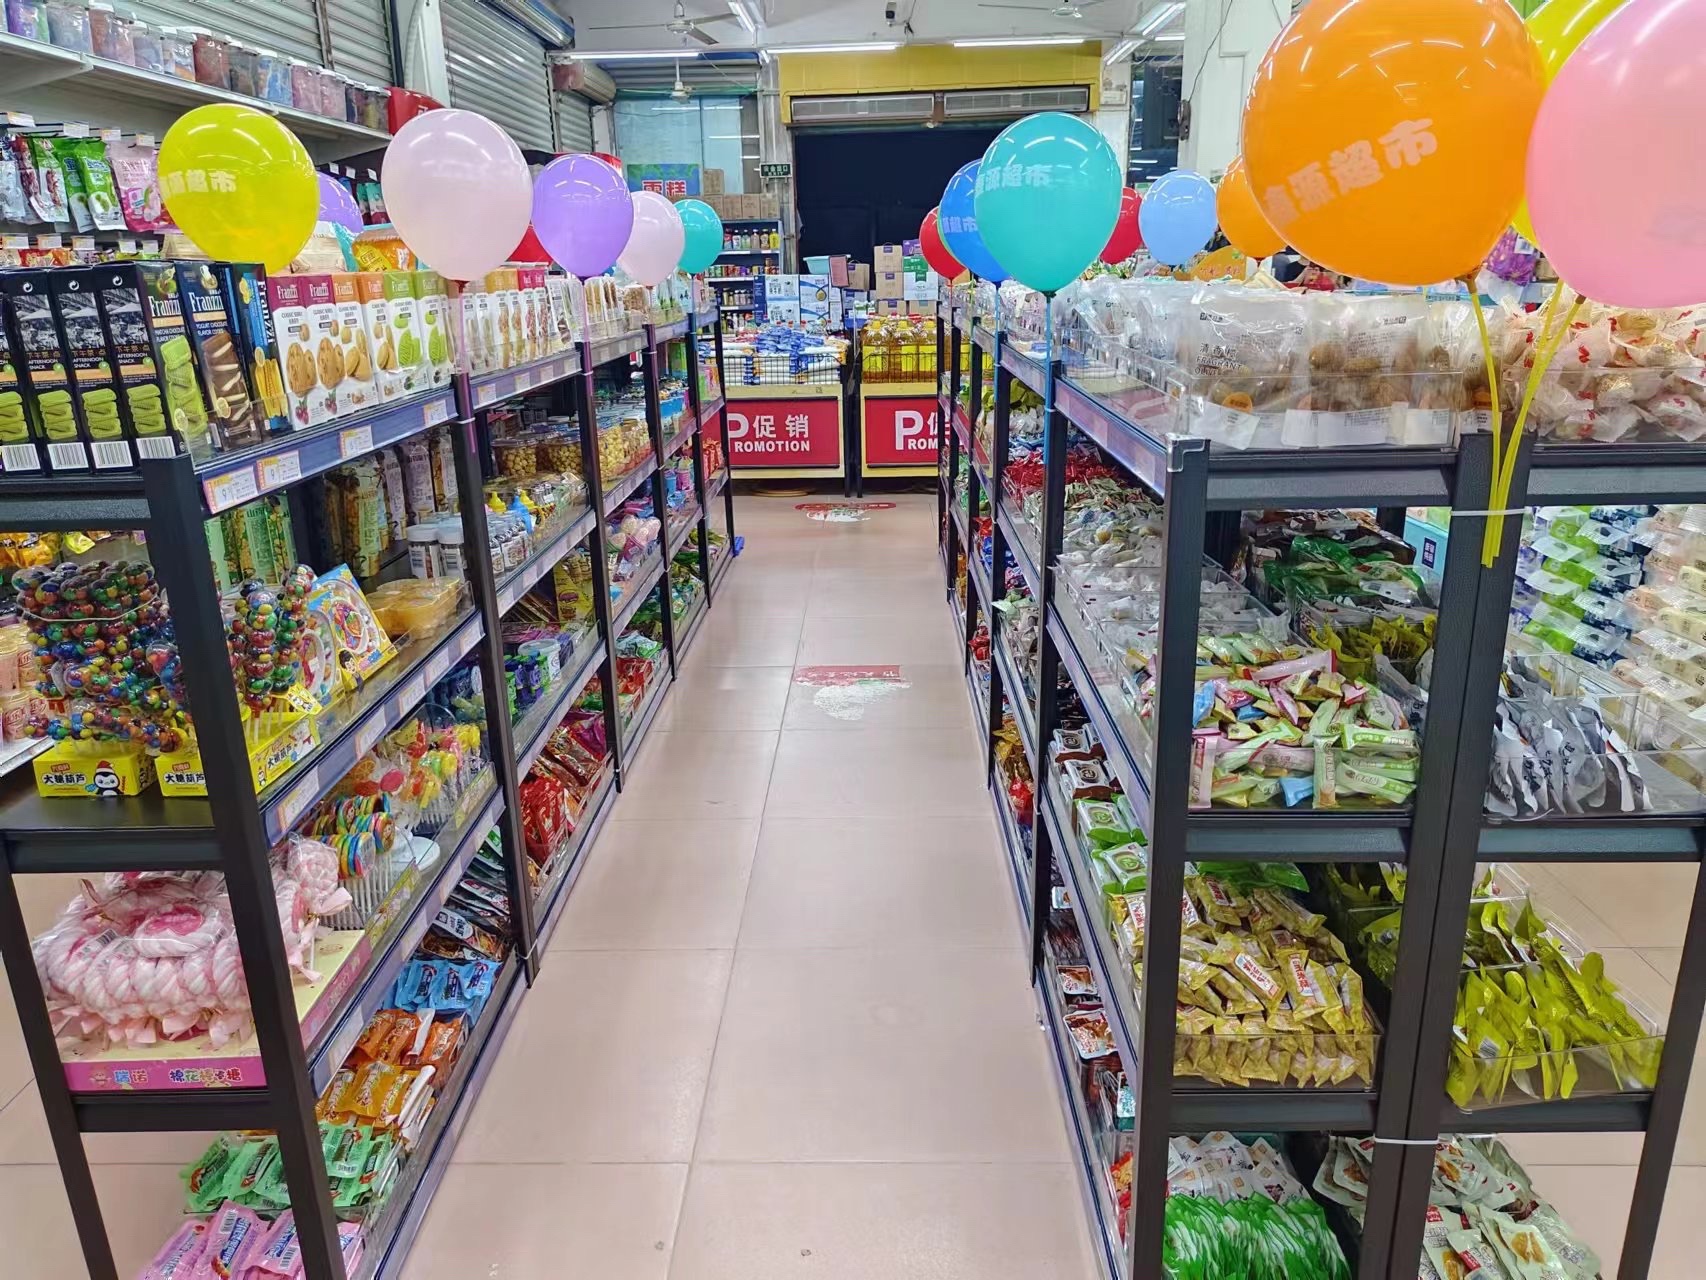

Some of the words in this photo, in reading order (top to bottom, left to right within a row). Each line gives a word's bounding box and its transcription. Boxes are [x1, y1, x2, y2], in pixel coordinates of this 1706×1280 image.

[188, 289, 224, 312] Franzzi
[73, 356, 104, 364] AFTERNOON
[1196, 355, 1244, 371] FRAGRANT
[43, 774, 86, 784] 大糖葫芦
[165, 774, 205, 784] 大糖葫芦
